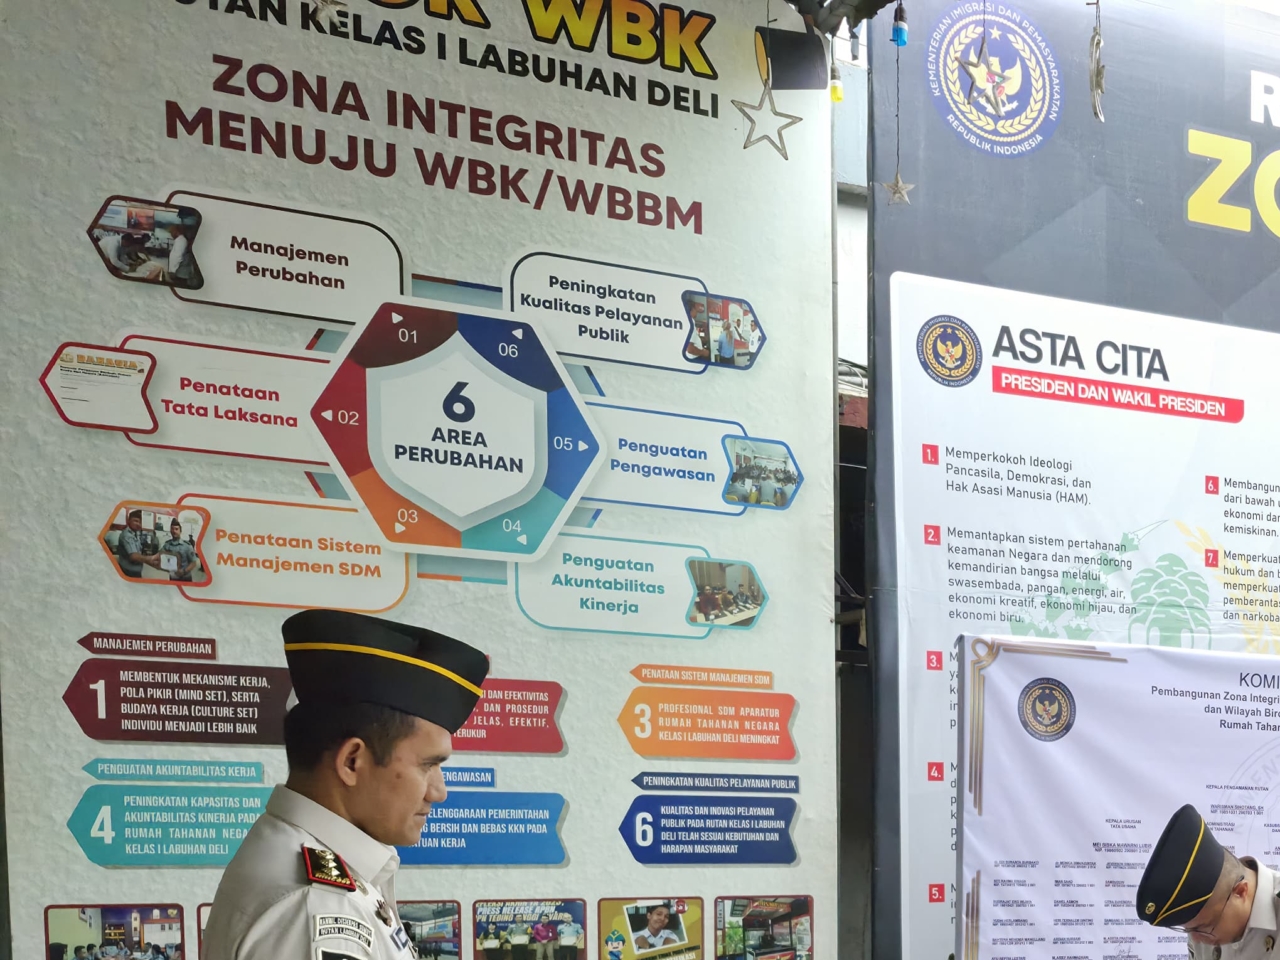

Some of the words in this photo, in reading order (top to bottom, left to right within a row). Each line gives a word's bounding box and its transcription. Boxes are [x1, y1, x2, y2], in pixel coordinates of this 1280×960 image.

[521, 0, 718, 79] WBK
[299, 2, 425, 54] KELAS
[438, 32, 446, 60] I
[459, 39, 636, 100] LABUHAN
[648, 80, 718, 118] DELI
[927, 16, 952, 97] KEMENTERIAN
[951, 2, 995, 20] IMIGRASI
[998, 5, 1021, 23] DAN
[1022, 20, 1061, 121] PEMASYARAKATAN
[212, 55, 369, 120] ZONA
[387, 92, 665, 176] INTEGRITAS
[946, 113, 991, 152] REPUBLIK
[993, 133, 1044, 154] INDONESIA
[166, 102, 396, 176] MENUJU
[414, 150, 702, 232] WBK/WBBM
[230, 236, 348, 266] Manajemen
[236, 261, 344, 289] Perubahan
[549, 276, 655, 309] Peningkatan
[521, 293, 590, 315] Kualitas
[595, 305, 682, 329] Pelayanan
[399, 328, 416, 343] 01
[578, 324, 629, 343] Publik
[499, 342, 518, 358] 06
[992, 325, 1085, 369] ASTA
[1096, 340, 1170, 383] CITA
[180, 377, 279, 401] Penataan
[1001, 373, 1074, 399] PRESIDEN
[1078, 383, 1108, 401] DAN
[1112, 388, 1156, 407] WAKIL
[1159, 394, 1225, 416] PRESIDEN
[161, 399, 208, 417] Tata
[214, 406, 297, 427] Laksana
[443, 382, 475, 422] 6
[338, 410, 359, 426] 02
[431, 427, 487, 448] AREA
[554, 436, 572, 451] 05
[615, 438, 707, 461] Penguatan
[395, 445, 523, 472] PERUBAHAN
[611, 459, 715, 482] Pengawasan
[946, 447, 1026, 465] Memperkokoh
[1030, 456, 1072, 472] Ideologi
[946, 463, 1003, 481] Pancasila,
[1007, 469, 1068, 487] Demokrasi,
[1072, 477, 1091, 488] dan
[1224, 478, 1280, 494] Membangun
[947, 480, 968, 492] Hak
[972, 483, 1002, 496] Asasi
[1007, 486, 1051, 501] Manusia
[1056, 491, 1090, 506] (HAM).
[396, 508, 418, 526] 03
[503, 519, 521, 532] 04
[215, 529, 312, 549] Penataan
[318, 537, 384, 555] Sistem
[1224, 523, 1278, 537] kemiskinan.
[216, 553, 334, 574] Manajemen
[339, 562, 381, 578] SDM
[560, 553, 654, 578] Penguatan
[552, 574, 664, 594] Akuntabilitas
[580, 597, 638, 615] Kinerja
[94, 638, 153, 651] MANAJEMEN
[156, 641, 211, 654] PERUBAHAN
[120, 671, 180, 683] MEMBENTUK
[183, 673, 237, 686] MEKANISME
[240, 676, 270, 688] KERJA,
[642, 668, 680, 679] PENATAAN
[681, 671, 708, 681] SISTEM
[709, 672, 753, 683] MANAJEMEN
[754, 675, 770, 685] SDM
[90, 680, 106, 719] 1
[1152, 686, 1220, 700] Pembangunan
[1223, 691, 1247, 702] Zona
[635, 704, 651, 738] 3
[1220, 719, 1252, 730] Rumah
[98, 763, 153, 775] PENGUATAN
[156, 765, 226, 776] AKUNTABILITAS
[228, 766, 256, 777] KERJA
[644, 776, 693, 786] PENINGKATAN
[694, 777, 728, 787] KUALITAS
[730, 778, 770, 788] PELAYANAN
[771, 779, 796, 789] PUBLIK
[91, 805, 115, 844] 4
[636, 812, 653, 846] 6
